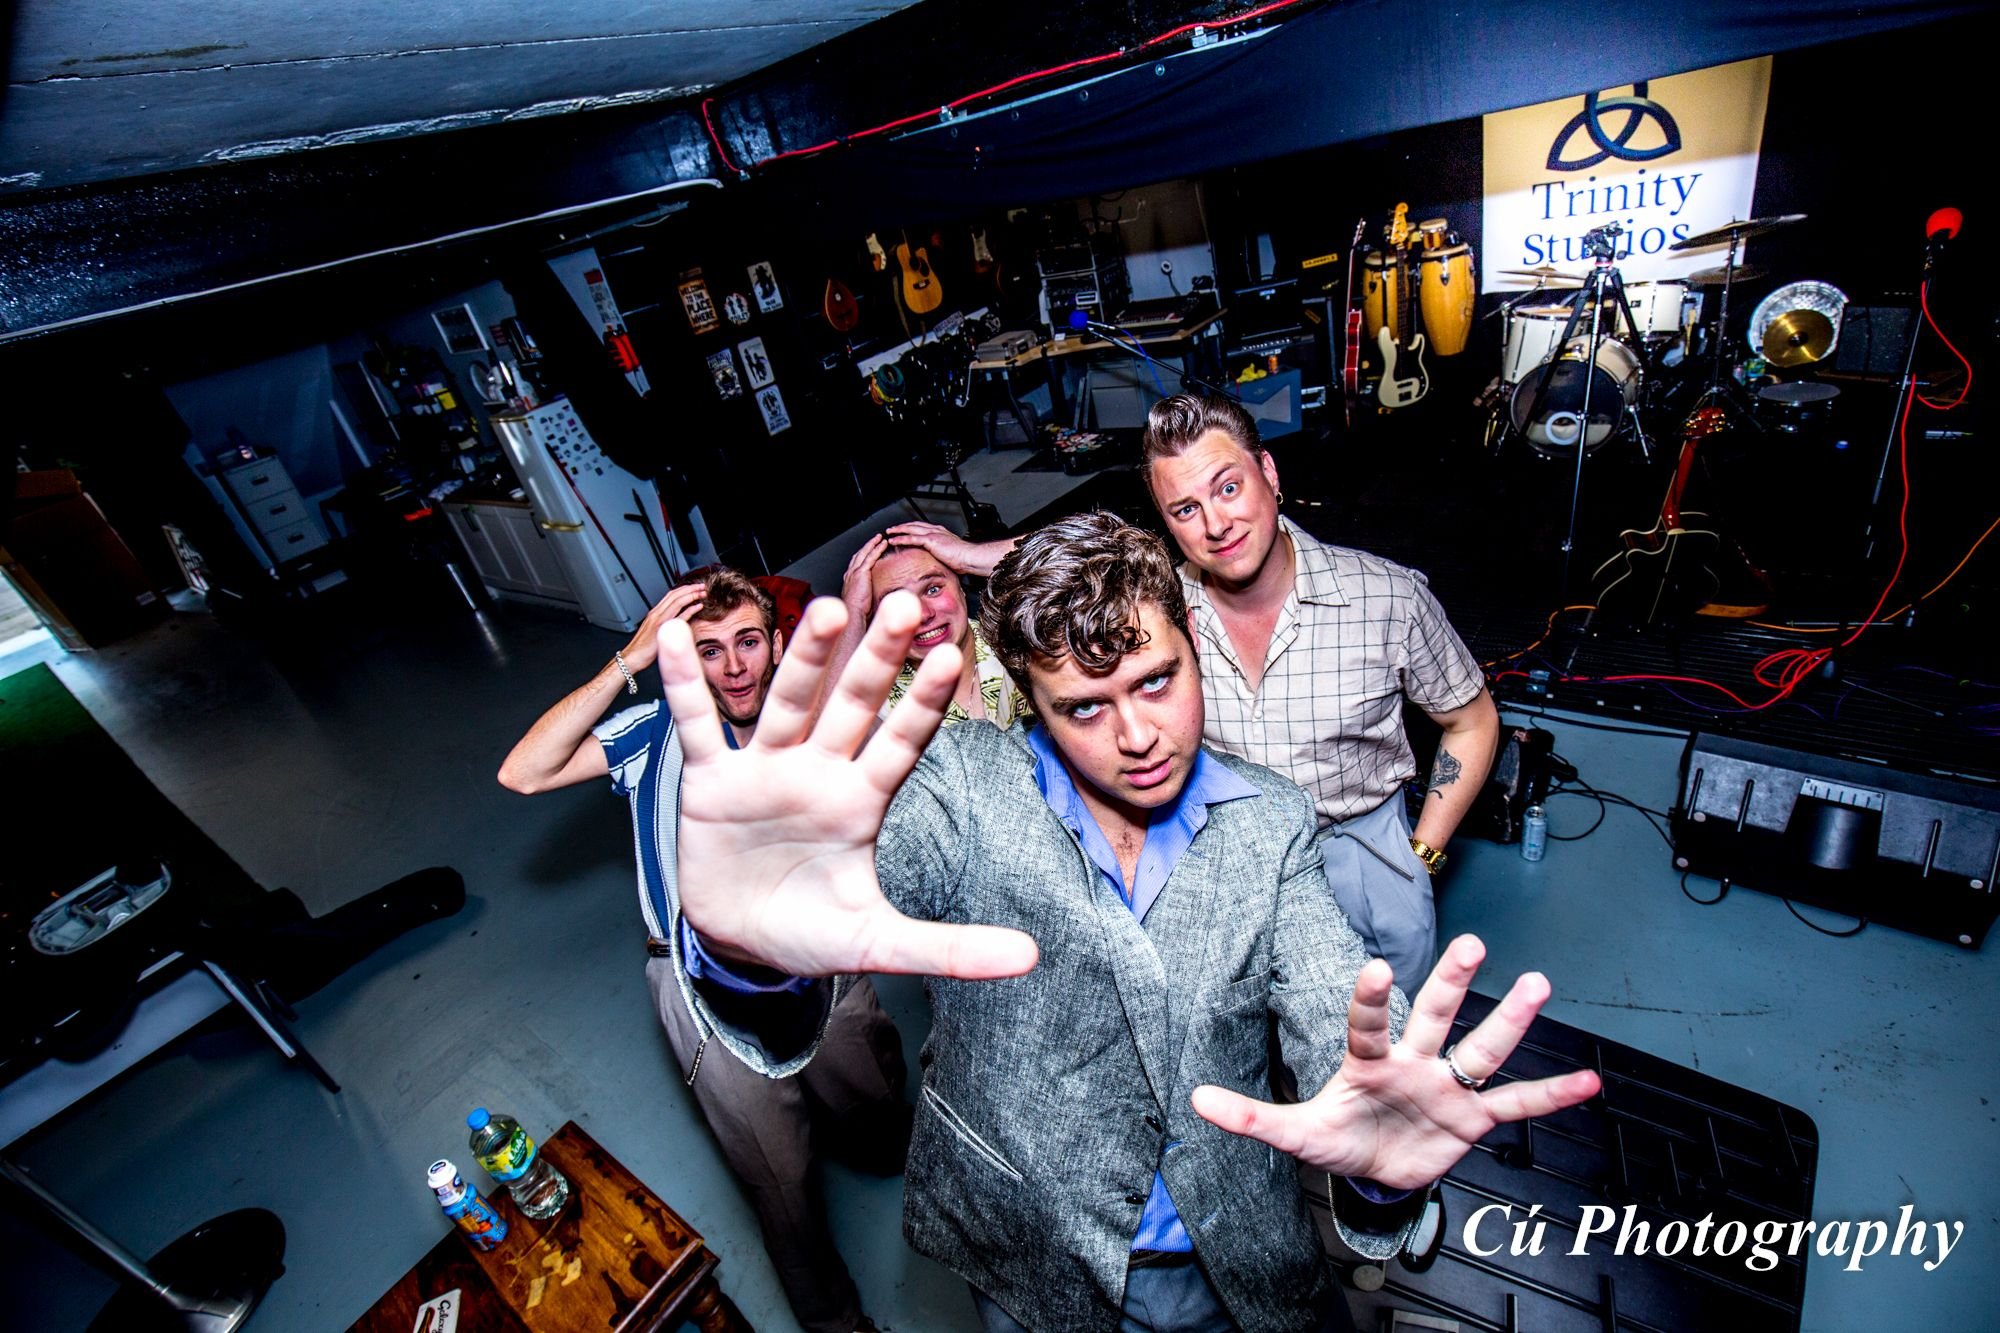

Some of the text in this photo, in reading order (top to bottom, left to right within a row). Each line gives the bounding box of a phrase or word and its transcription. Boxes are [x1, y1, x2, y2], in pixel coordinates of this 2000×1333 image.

[1531, 168, 1703, 219] Trinity
[687, 298, 713, 315] PLACE
[692, 311, 716, 325] WHERE
